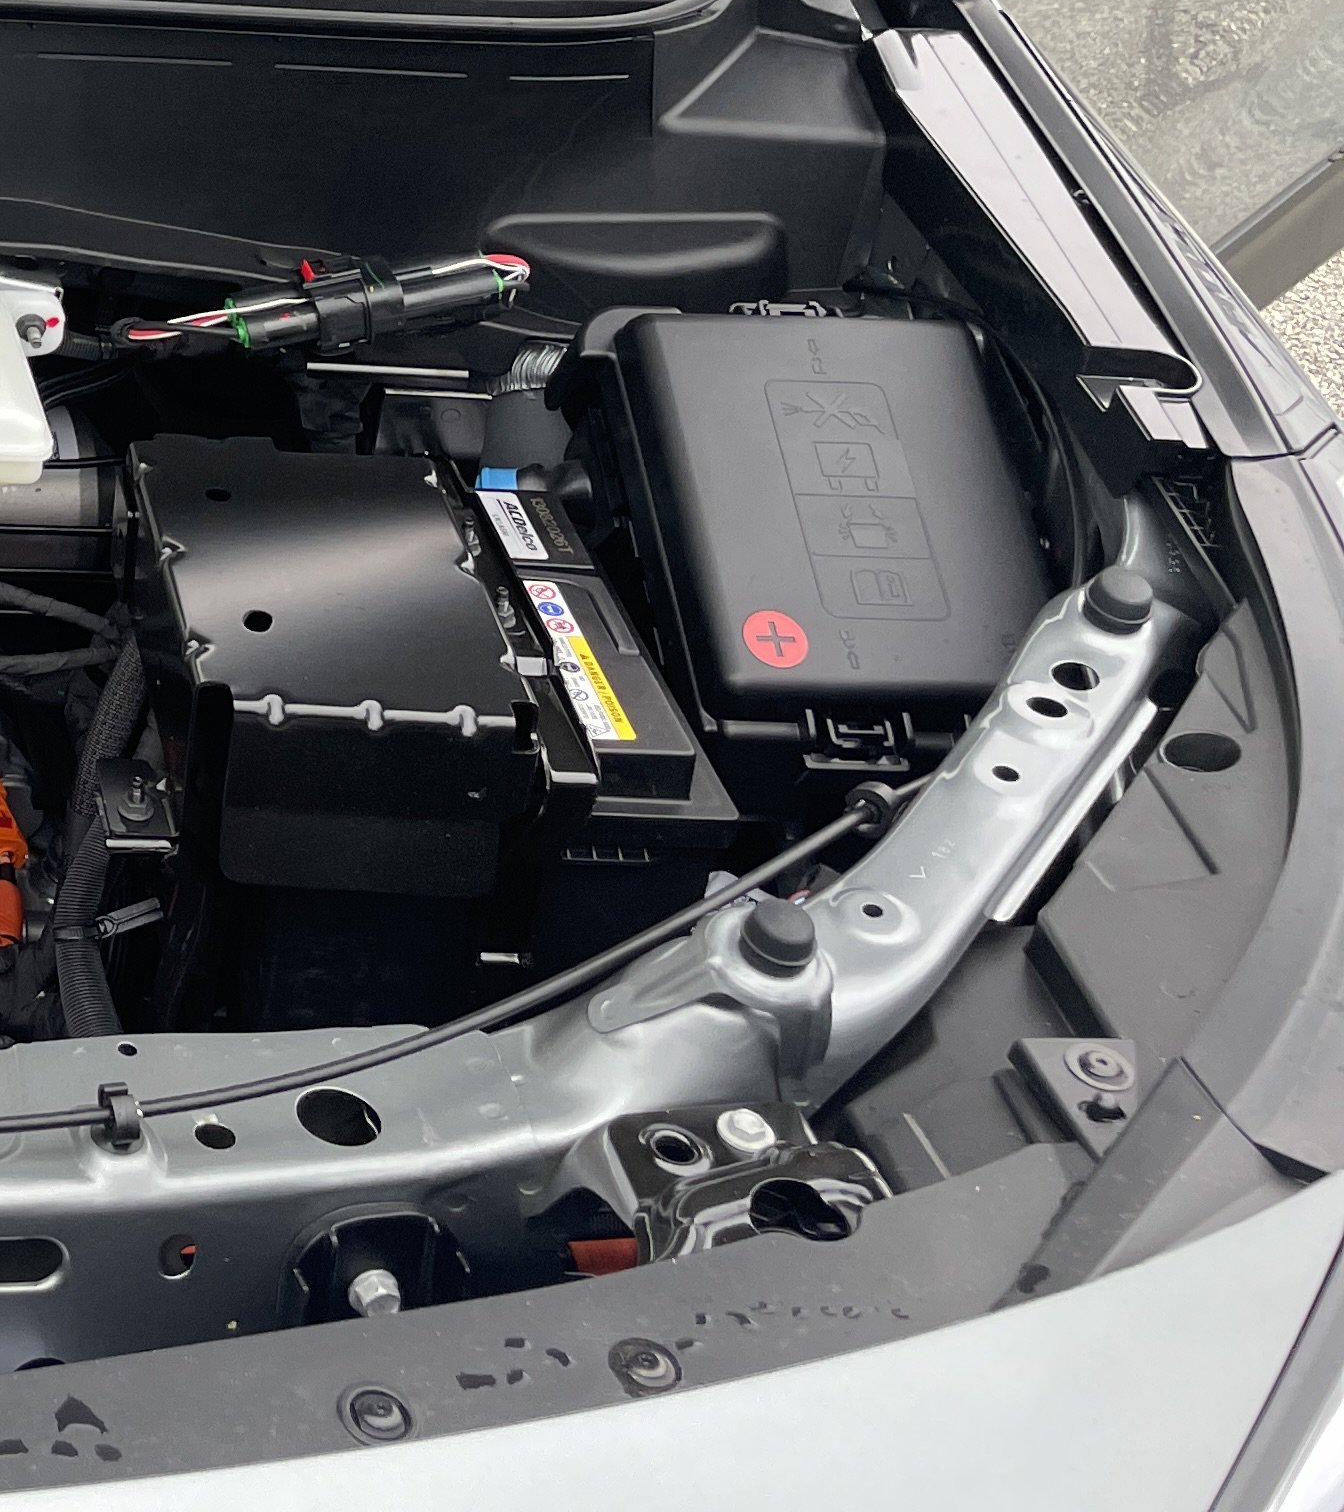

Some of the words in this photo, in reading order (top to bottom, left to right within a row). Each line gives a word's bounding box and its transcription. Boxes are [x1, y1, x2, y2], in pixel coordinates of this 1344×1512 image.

[502, 500, 538, 550] ACDelco
[583, 660, 605, 689] DANGER
[601, 694, 623, 723] POISON
